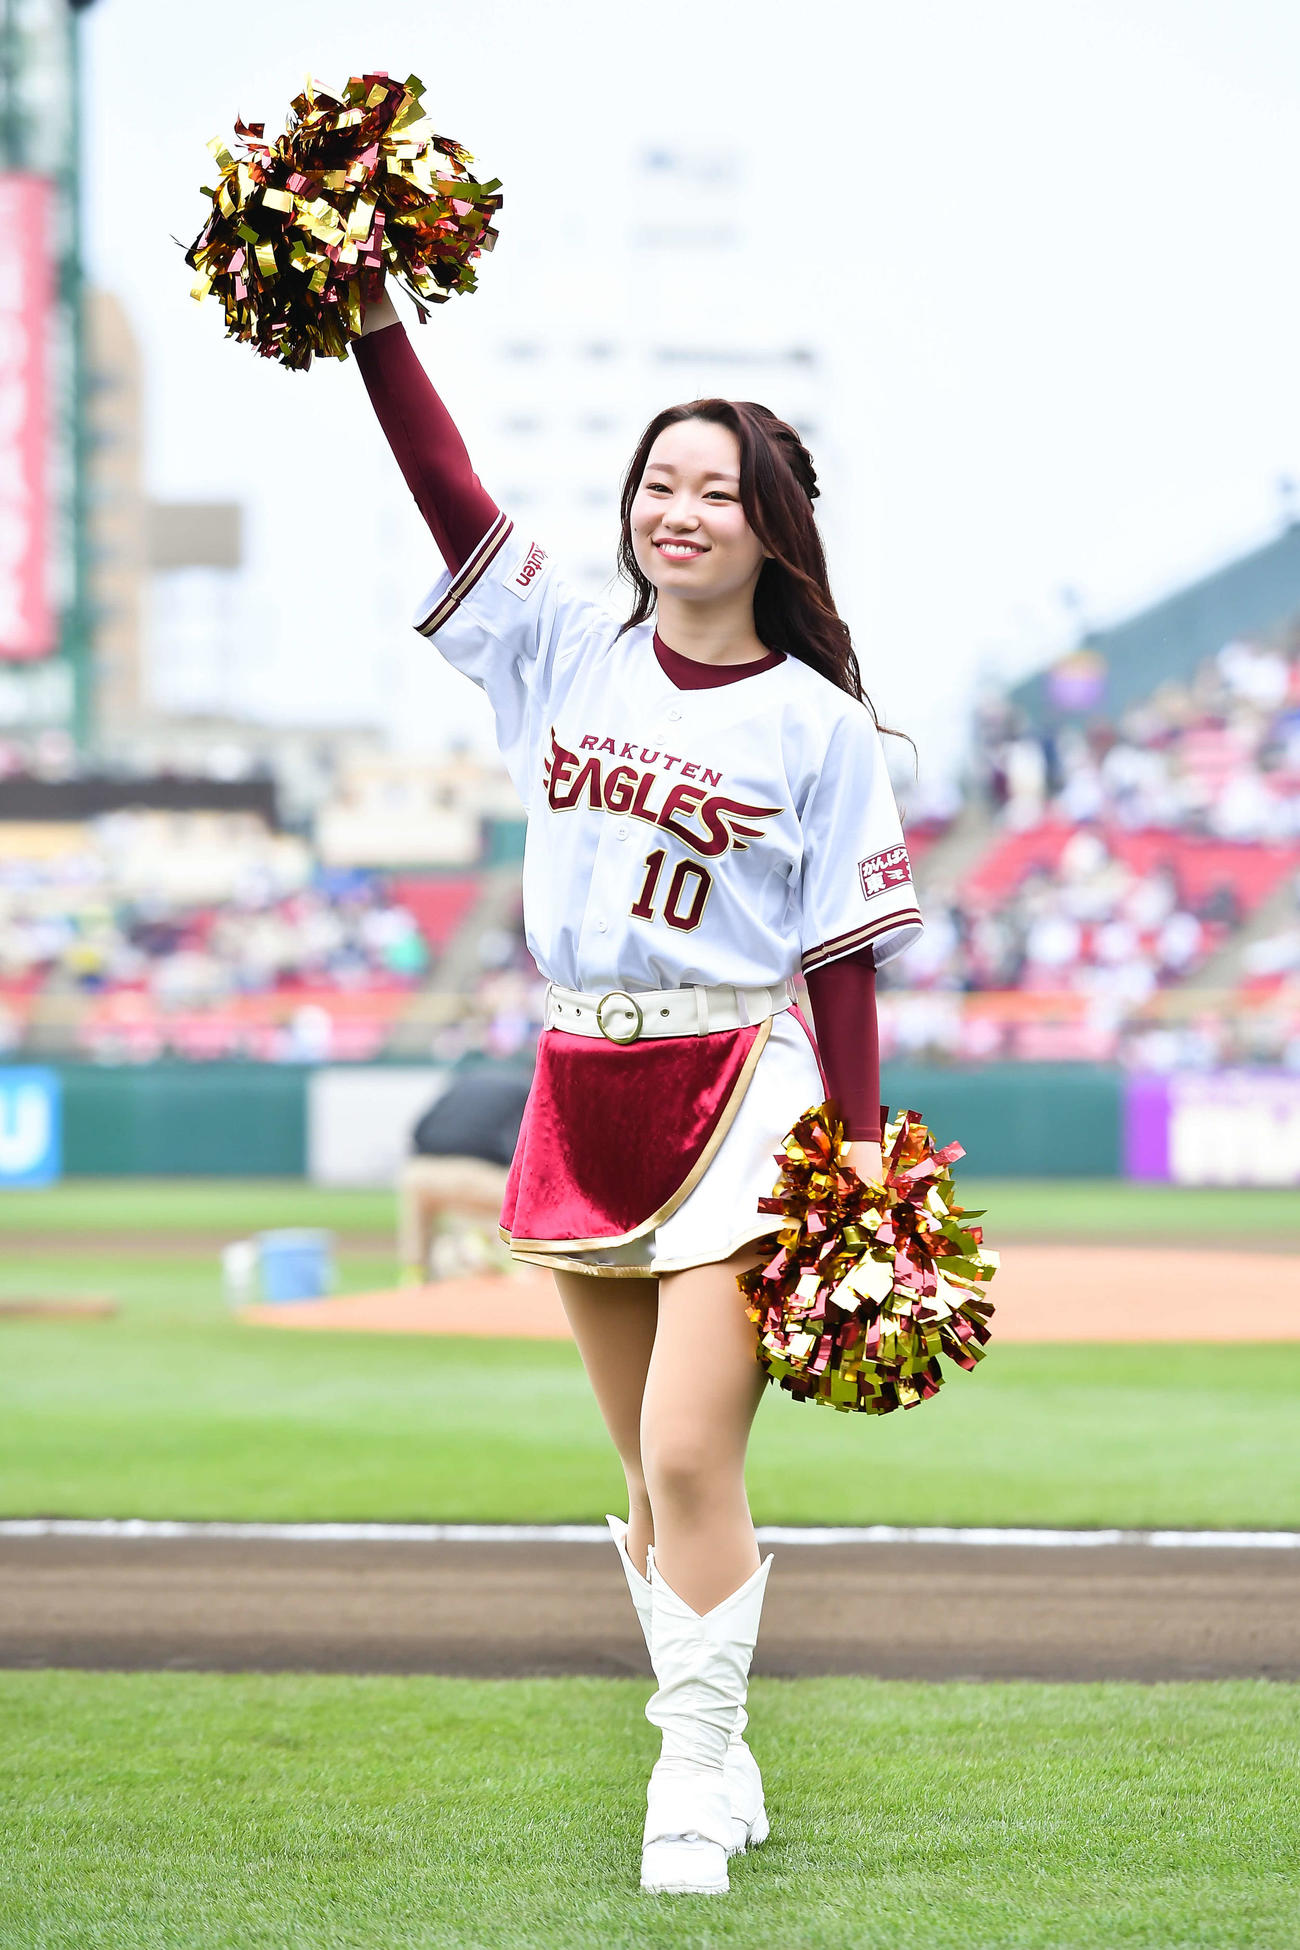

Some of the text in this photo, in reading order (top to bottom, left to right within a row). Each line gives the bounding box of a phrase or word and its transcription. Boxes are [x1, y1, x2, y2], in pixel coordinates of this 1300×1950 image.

[543, 726, 786, 860] EAGLES
[579, 734, 723, 788] RAKUTEN
[629, 849, 714, 934] 10
